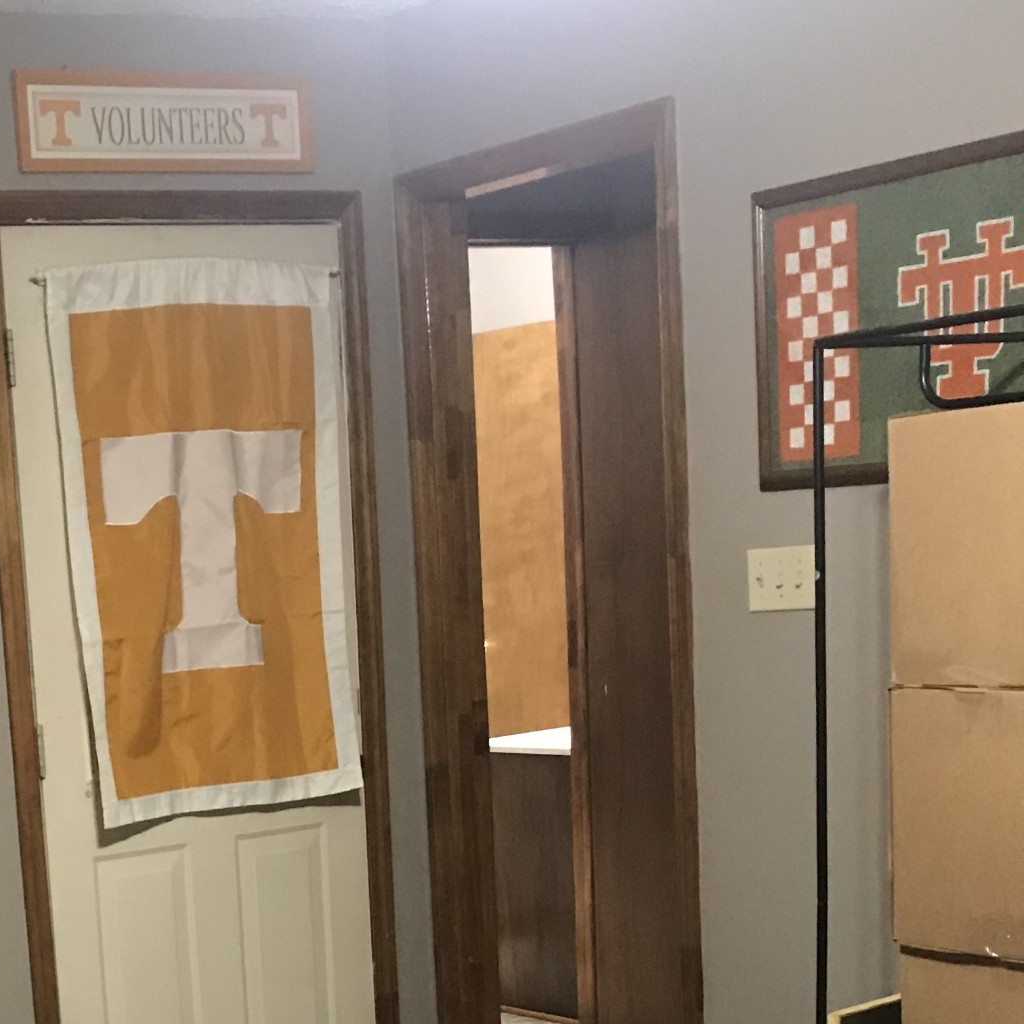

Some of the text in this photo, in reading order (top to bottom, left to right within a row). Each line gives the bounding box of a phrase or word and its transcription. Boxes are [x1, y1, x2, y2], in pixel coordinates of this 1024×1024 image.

[39, 99, 288, 149] T VOLUNTEERS T
[99, 428, 302, 674] T
